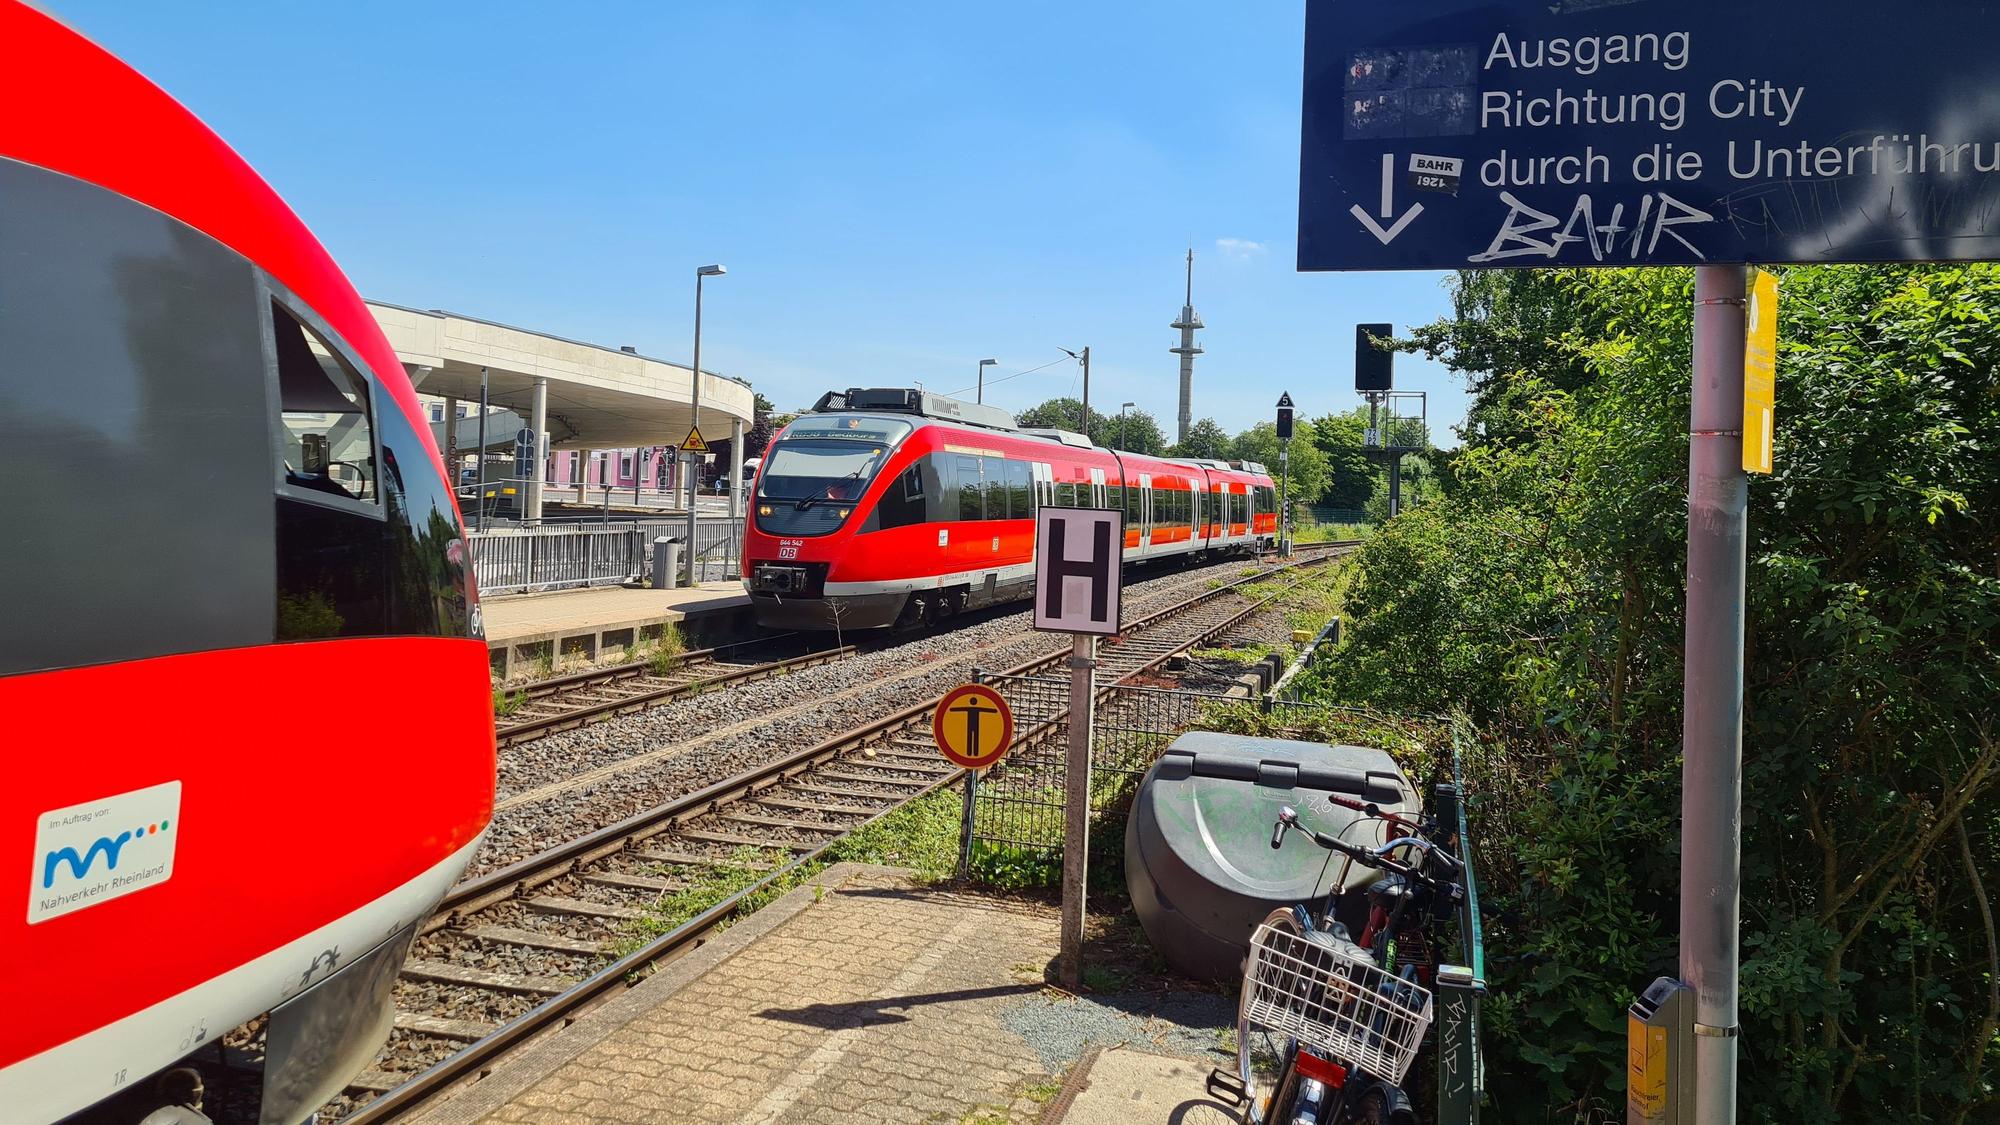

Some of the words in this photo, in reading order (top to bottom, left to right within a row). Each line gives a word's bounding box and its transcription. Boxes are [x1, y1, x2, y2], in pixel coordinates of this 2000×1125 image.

[1484, 31, 1690, 75] Ausgang
[1481, 88, 1687, 131] Richtung
[1709, 79, 1804, 125] City
[1416, 159, 1454, 172] BAHR
[1480, 145, 1610, 187] durch
[1632, 142, 1702, 182] die
[1727, 133, 2000, 180] Unterführu
[1467, 191, 1714, 262] BAHR
[1282, 396, 1289, 406] 5
[780, 548, 796, 558] DB
[1255, 541, 1263, 553] H
[1046, 518, 1111, 622] H
[49, 820, 61, 829] Im
[62, 809, 93, 827] Auftrag
[94, 807, 112, 819] von:
[39, 881, 110, 912] Nahverkehr
[111, 863, 166, 890] Rheinland
